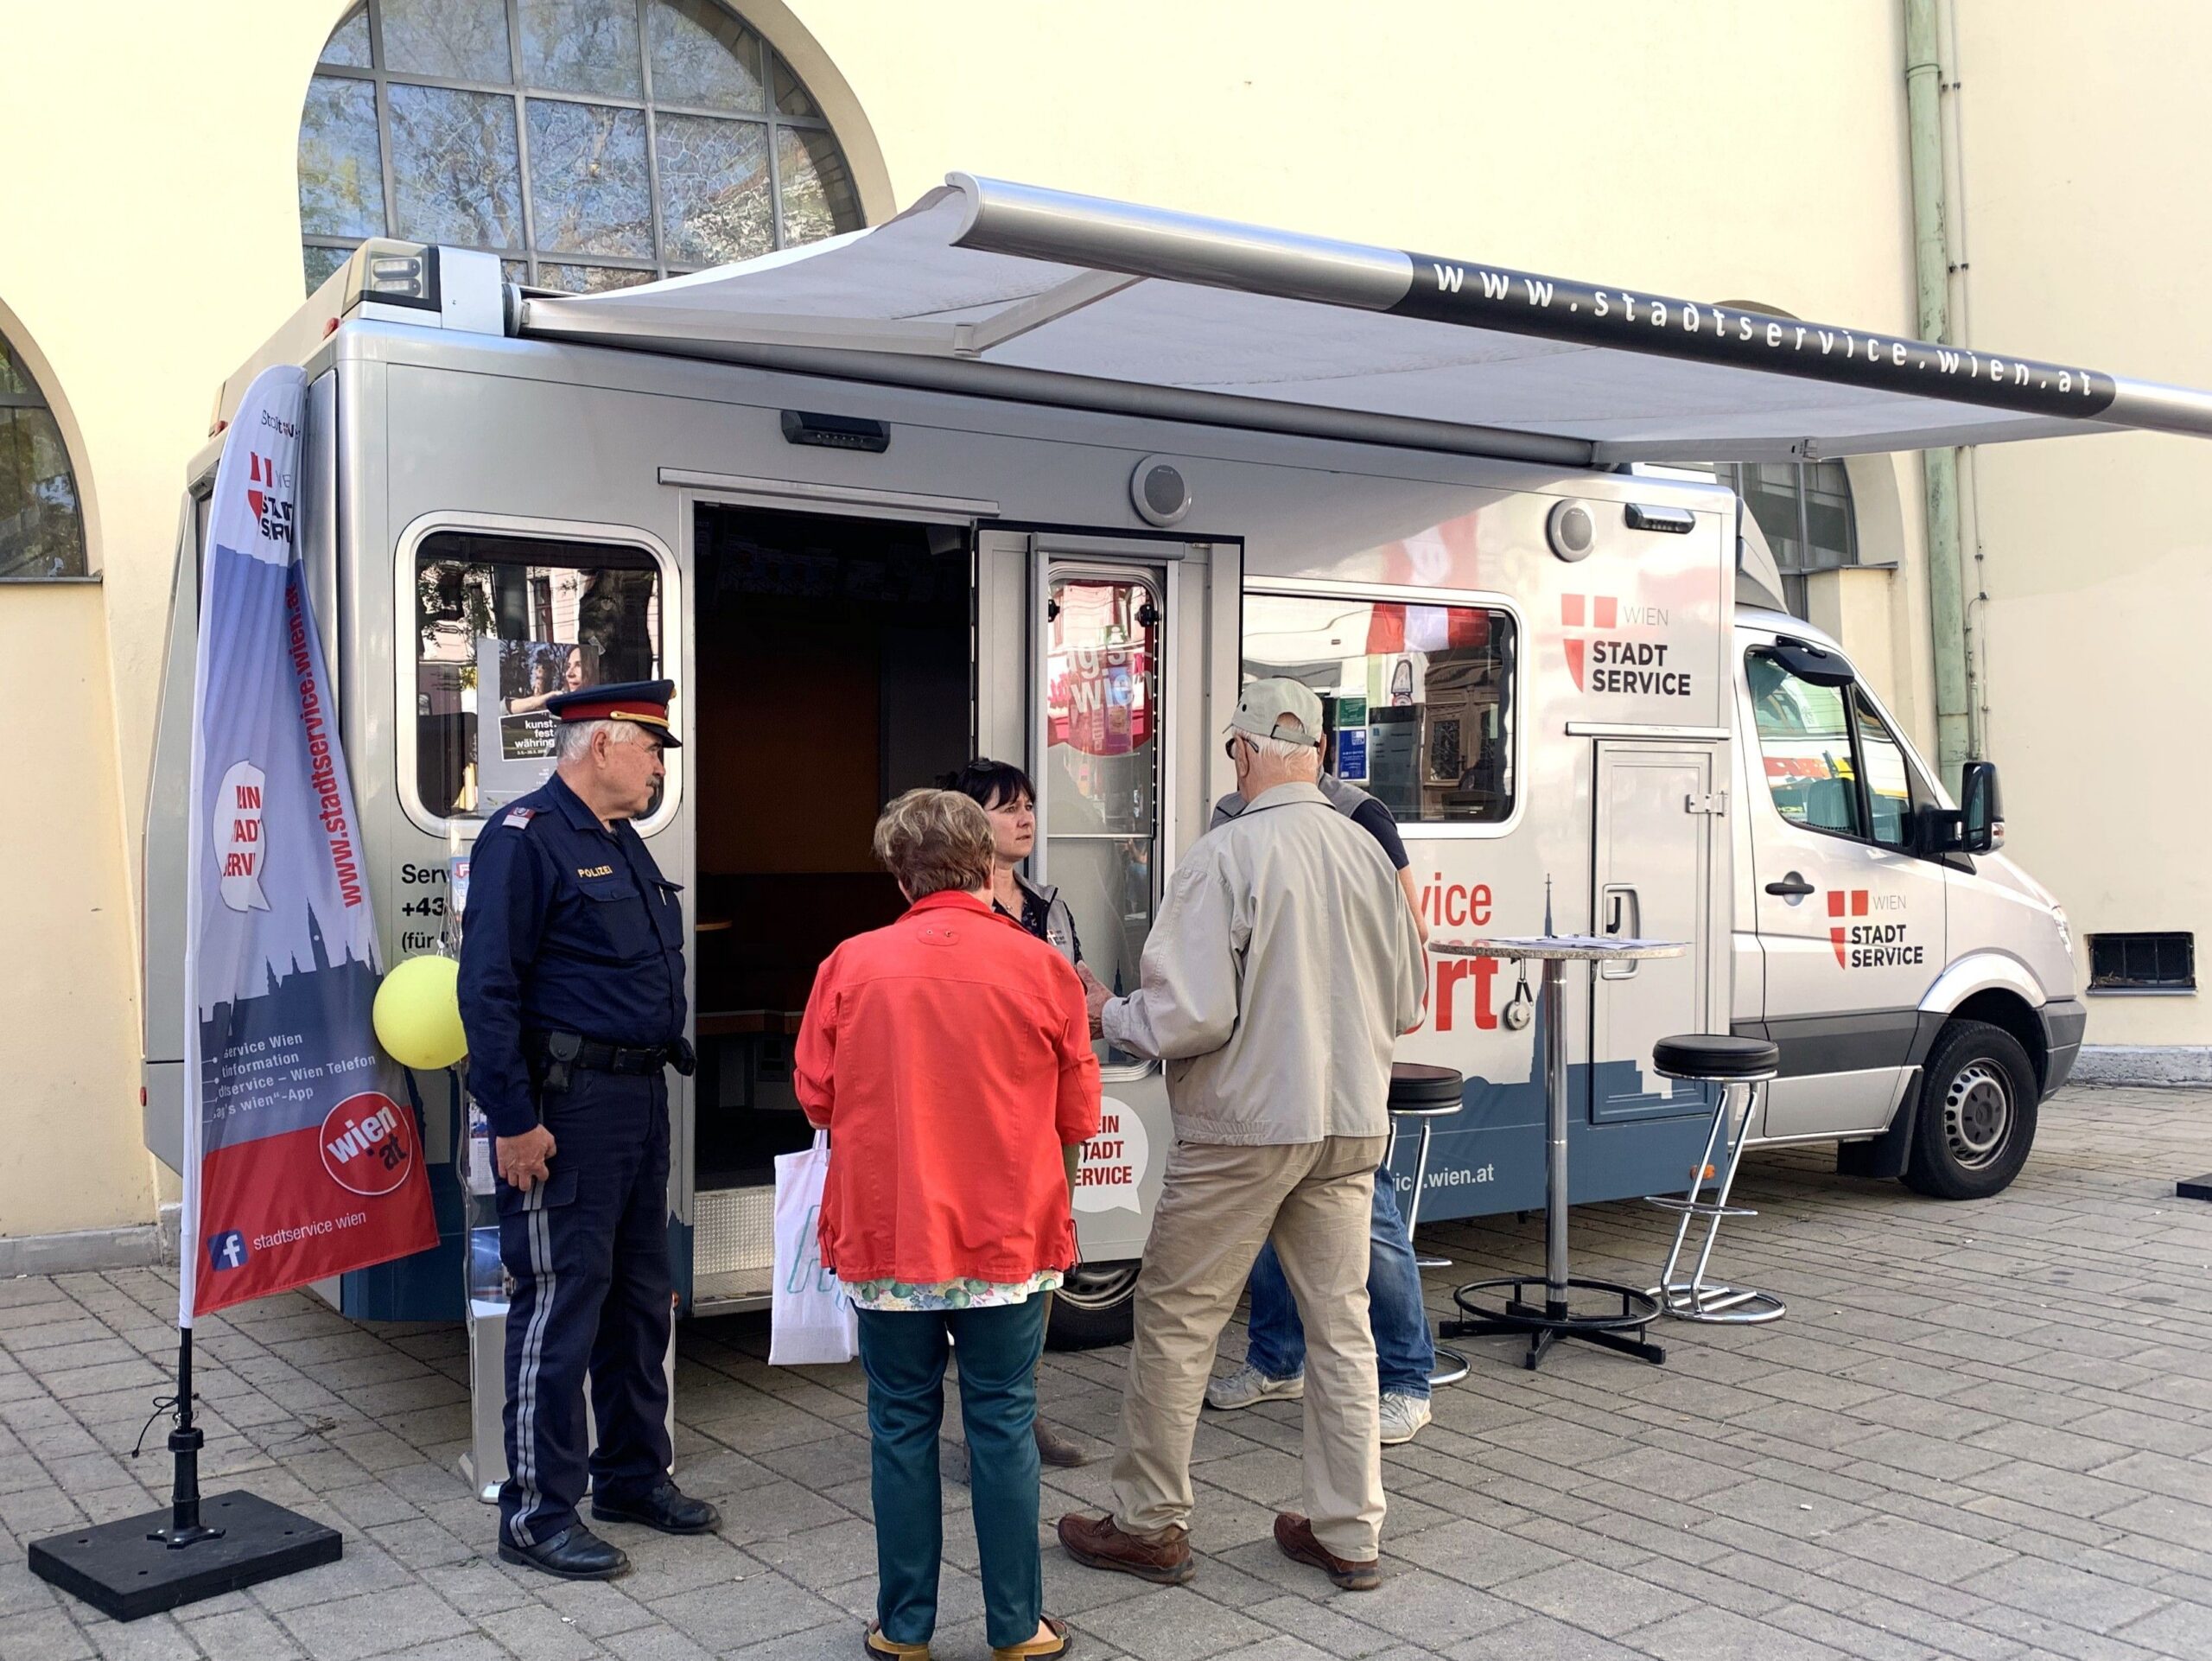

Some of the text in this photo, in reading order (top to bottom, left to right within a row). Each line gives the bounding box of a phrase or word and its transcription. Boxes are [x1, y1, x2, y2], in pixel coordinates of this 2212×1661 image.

[1433, 263, 2093, 397] www.stadtservice.wien.at
[1624, 606, 1669, 627] WIEN
[1592, 640, 1669, 667] STADT
[1592, 669, 1692, 697] SERVICE
[402, 863, 451, 884] Serv
[577, 864, 613, 878] POLIZEI
[1421, 872, 1491, 927] vice
[1872, 894, 1907, 910] WIEN
[402, 931, 435, 953] (für
[1851, 924, 1907, 945] STADT
[1851, 945, 1923, 968] SERVICE
[1403, 947, 1499, 1035] rt
[269, 1034, 303, 1049] Wien
[290, 1066, 324, 1082] Wien
[326, 1055, 376, 1075] Telefon
[327, 1106, 397, 1164] wien
[1080, 1140, 1125, 1161] TADT
[1074, 1166, 1133, 1187] ERVICE
[253, 1219, 334, 1251] stadtservice
[334, 1211, 367, 1230] wien
